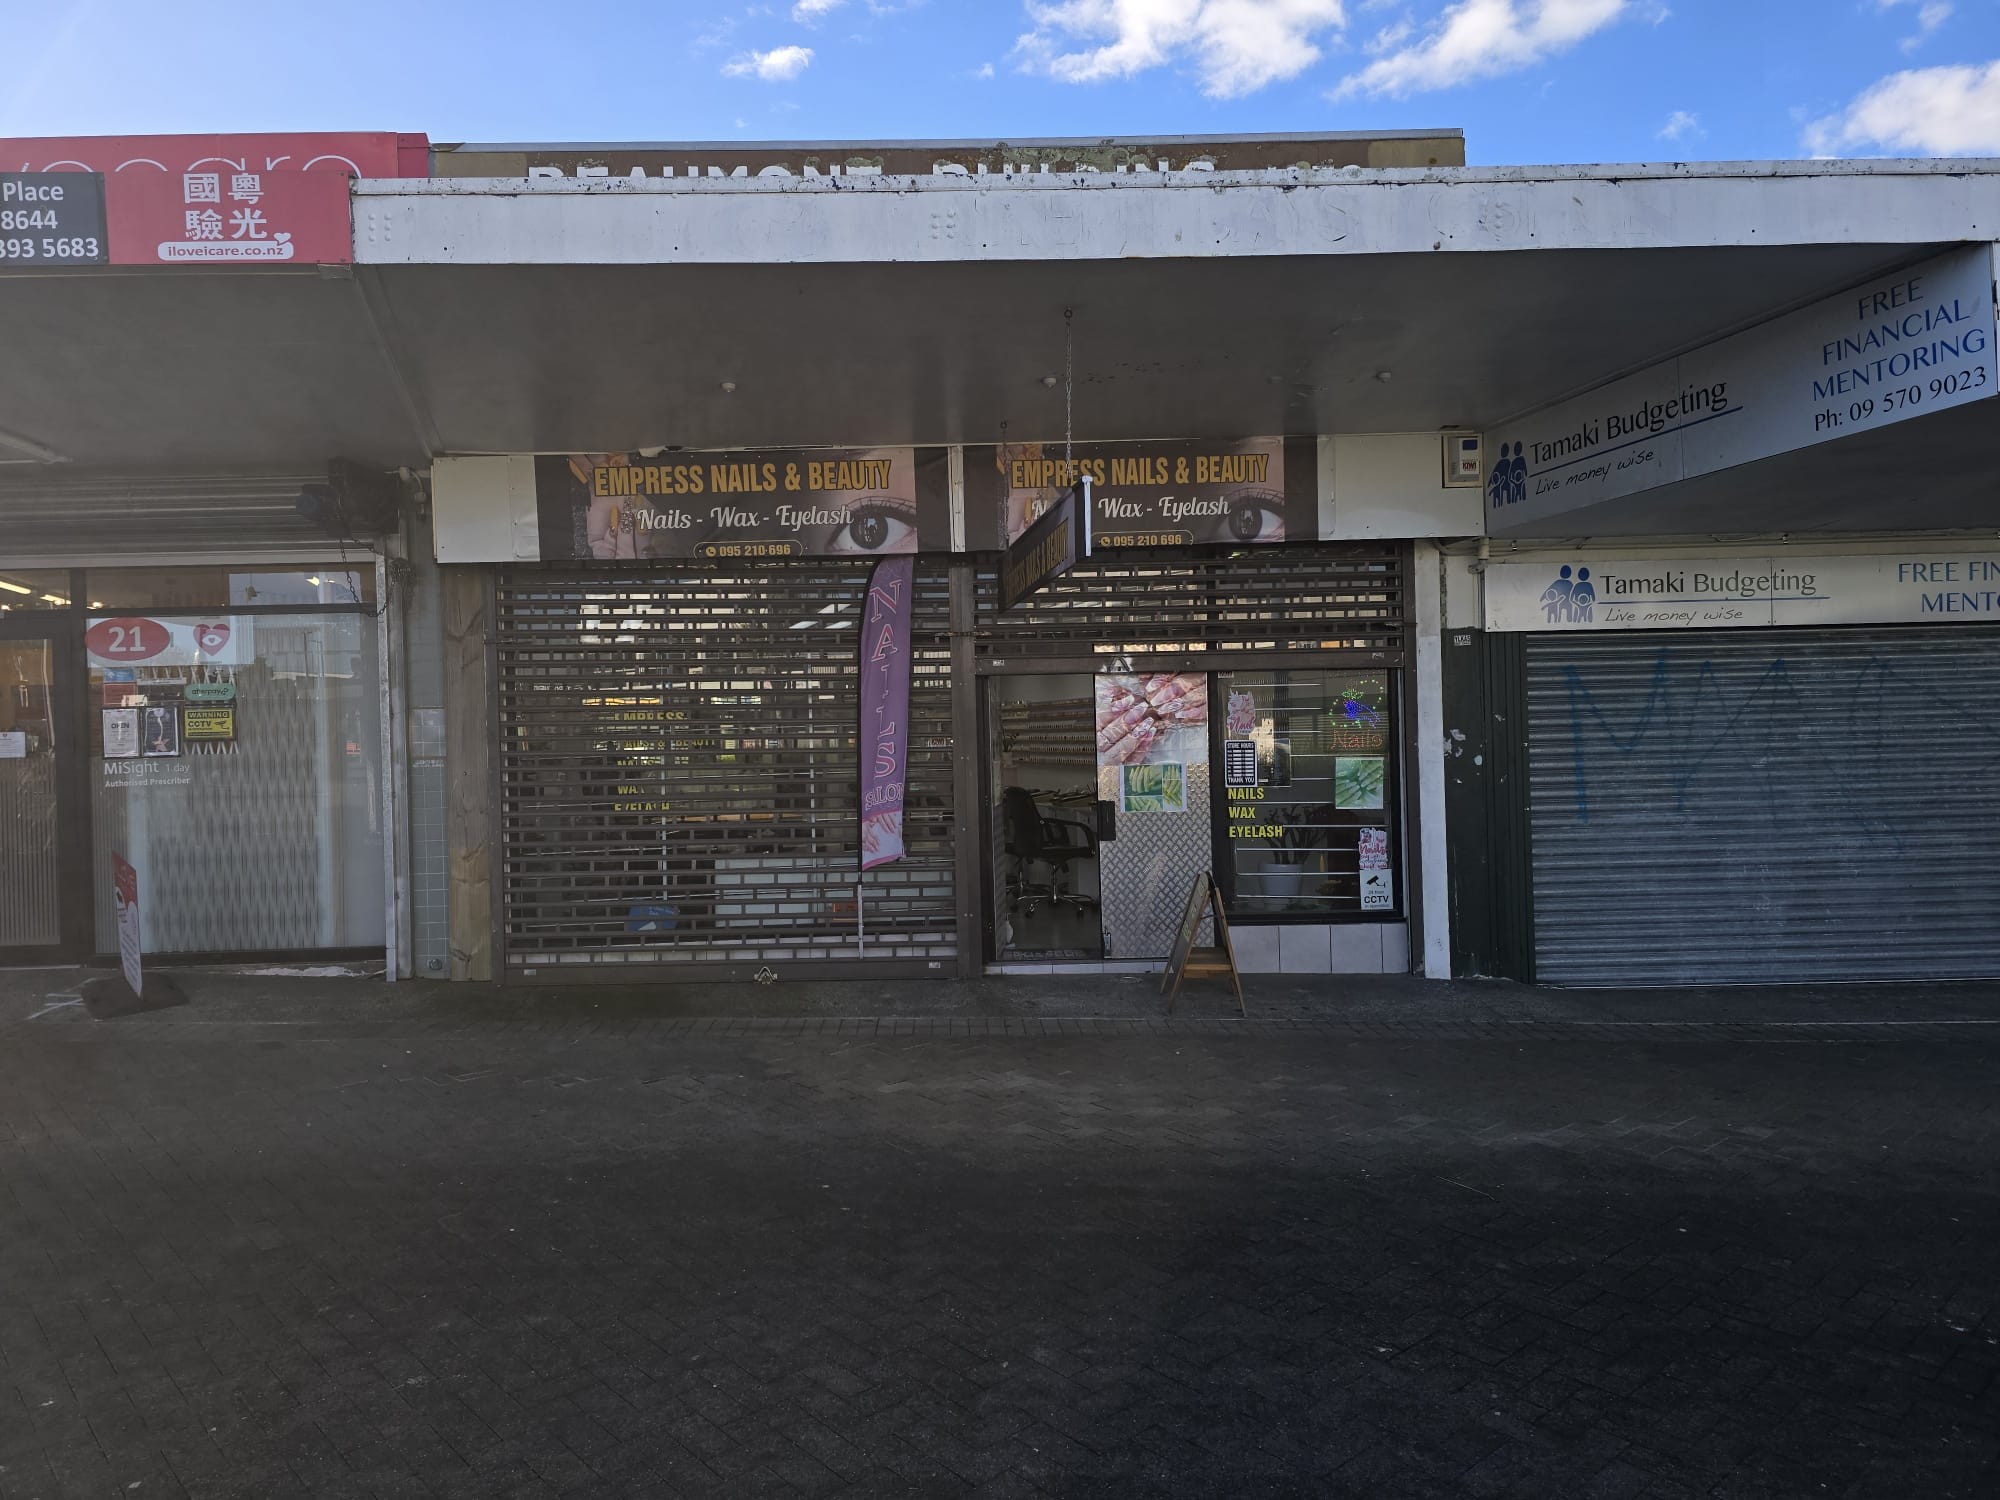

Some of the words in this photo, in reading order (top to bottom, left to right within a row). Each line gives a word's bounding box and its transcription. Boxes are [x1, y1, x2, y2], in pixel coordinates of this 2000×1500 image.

[2, 181, 64, 201] Place
[1, 210, 58, 230] 8644
[185, 208, 268, 240] 驗光
[42, 237, 99, 258] 5683
[168, 245, 284, 257] iloveicare.co.nz
[1858, 276, 1924, 320] FREE
[1823, 300, 1970, 366] FINANCIAL
[1812, 328, 1985, 401] MENTORING
[1815, 409, 1843, 432] Ph:
[1850, 399, 1874, 421] 09
[1883, 385, 1922, 413] 570
[1930, 366, 1986, 400] 9023
[1529, 419, 1599, 465] Tamaki
[1607, 382, 1727, 440] Budgeting
[594, 464, 704, 496] EMPRESS
[710, 463, 777, 493] NAILS
[784, 462, 801, 492] &
[808, 459, 892, 490] BEAUTY
[1111, 456, 1169, 486] NAILS
[1175, 456, 1190, 484] &
[1196, 453, 1270, 483] BEAUTY
[1535, 477, 1560, 495] Live
[1565, 462, 1611, 487] money
[1617, 449, 1654, 470] wise
[637, 508, 692, 530] Nails
[710, 506, 760, 527] Wax
[775, 504, 854, 531] Eyelash
[1098, 498, 1144, 518] Wax
[1158, 496, 1232, 522] Eyelash
[719, 546, 741, 556] 095
[744, 545, 767, 556] 210
[768, 544, 791, 555] 696
[1113, 535, 1134, 547] 095
[1137, 535, 1157, 546] 210
[1160, 534, 1182, 545] 696
[1898, 562, 1959, 582] FREE
[1600, 571, 1684, 594] Tamaki
[1694, 569, 1816, 597] Budgeting
[1921, 591, 2000, 613] MENT
[1604, 607, 1636, 622] Live
[1643, 611, 1697, 626] money
[1703, 607, 1744, 621] wise
[108, 626, 146, 653] 21
[104, 760, 160, 776] MiSight
[174, 763, 190, 774] day
[105, 779, 148, 788] Authorised
[150, 777, 190, 786] Prescriber
[1228, 788, 1264, 800] NAILS
[1228, 807, 1256, 819] WAX
[1229, 825, 1283, 838] EYELASH
[1364, 895, 1389, 904] CCTV
